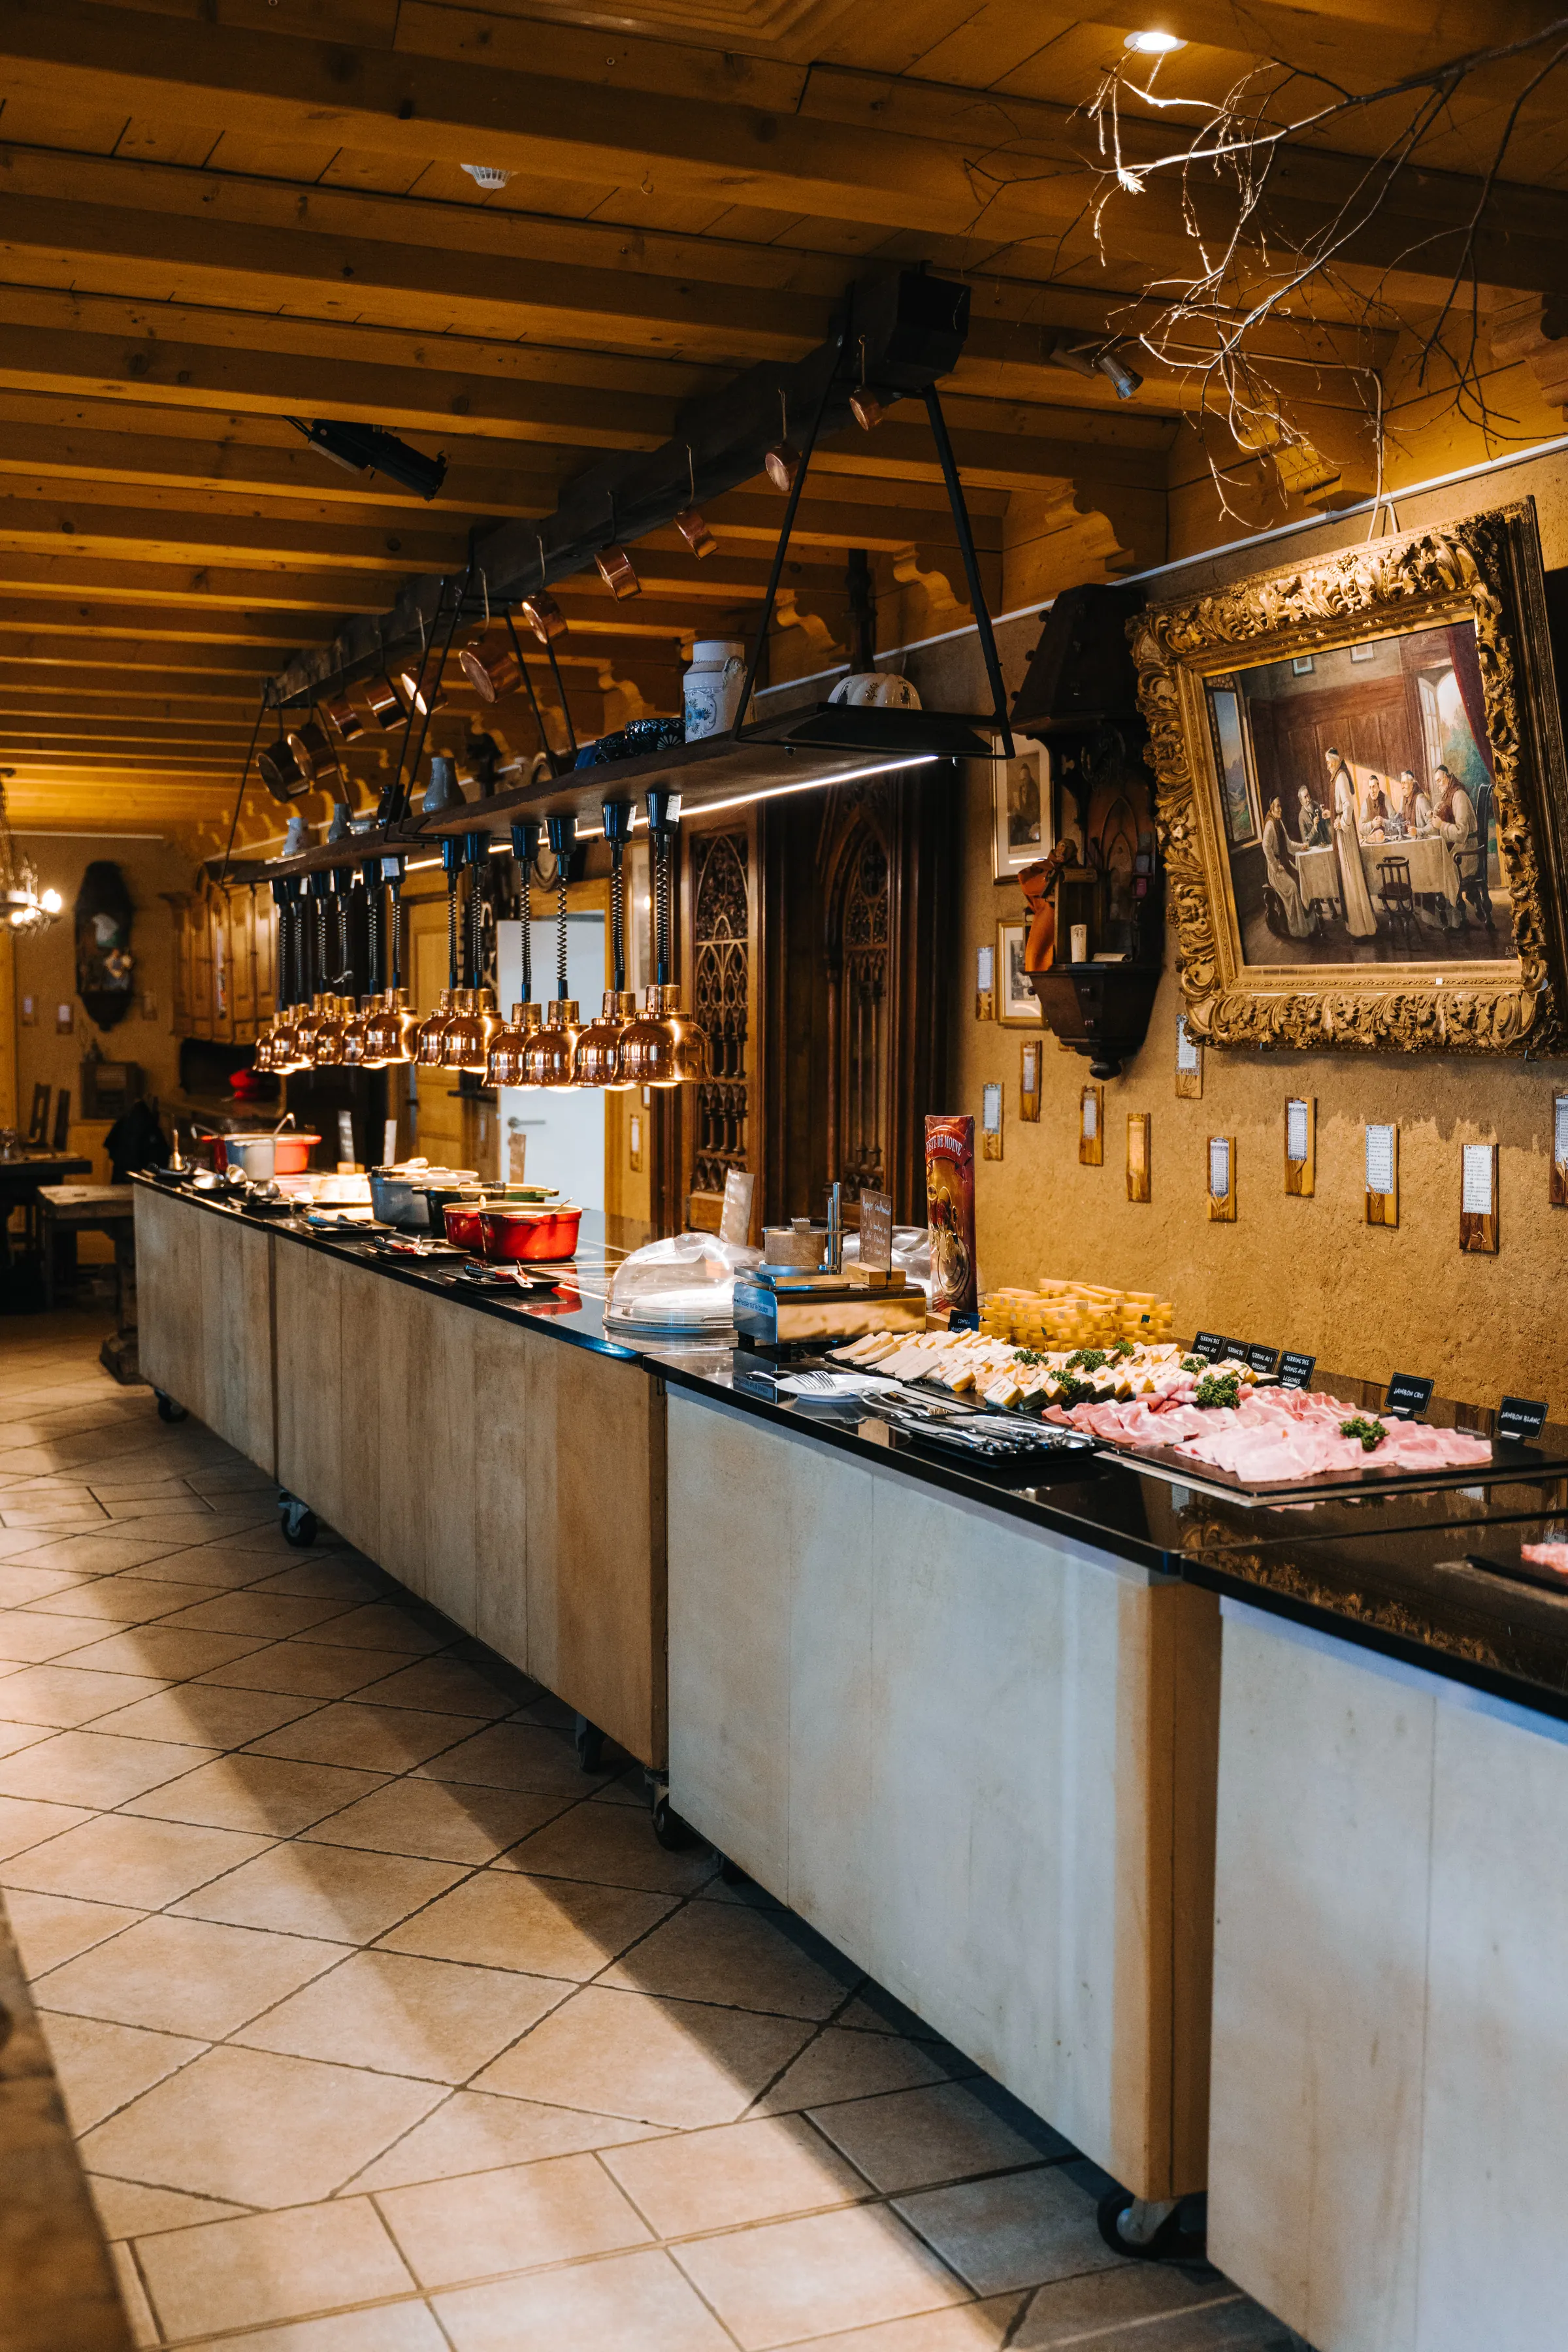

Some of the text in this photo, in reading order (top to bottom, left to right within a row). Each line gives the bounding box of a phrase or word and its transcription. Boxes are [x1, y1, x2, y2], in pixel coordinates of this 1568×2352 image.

[937, 1134, 943, 1147] DE
[944, 1135, 962, 1156] MOINE
[759, 1305, 768, 1314] bouton
[1200, 1335, 1213, 1344] TERRINE
[1228, 1347, 1239, 1355] TERRINE
[1252, 1352, 1265, 1362] TERRINE
[1286, 1355, 1301, 1364] TERRINE
[1251, 1362, 1267, 1371] POISSONS
[1283, 1365, 1307, 1376] MOINES AUX
[1282, 1375, 1301, 1384] LEGUMES
[1393, 1387, 1413, 1397] JAMBON
[1501, 1411, 1541, 1425] JAMBON BLANC
